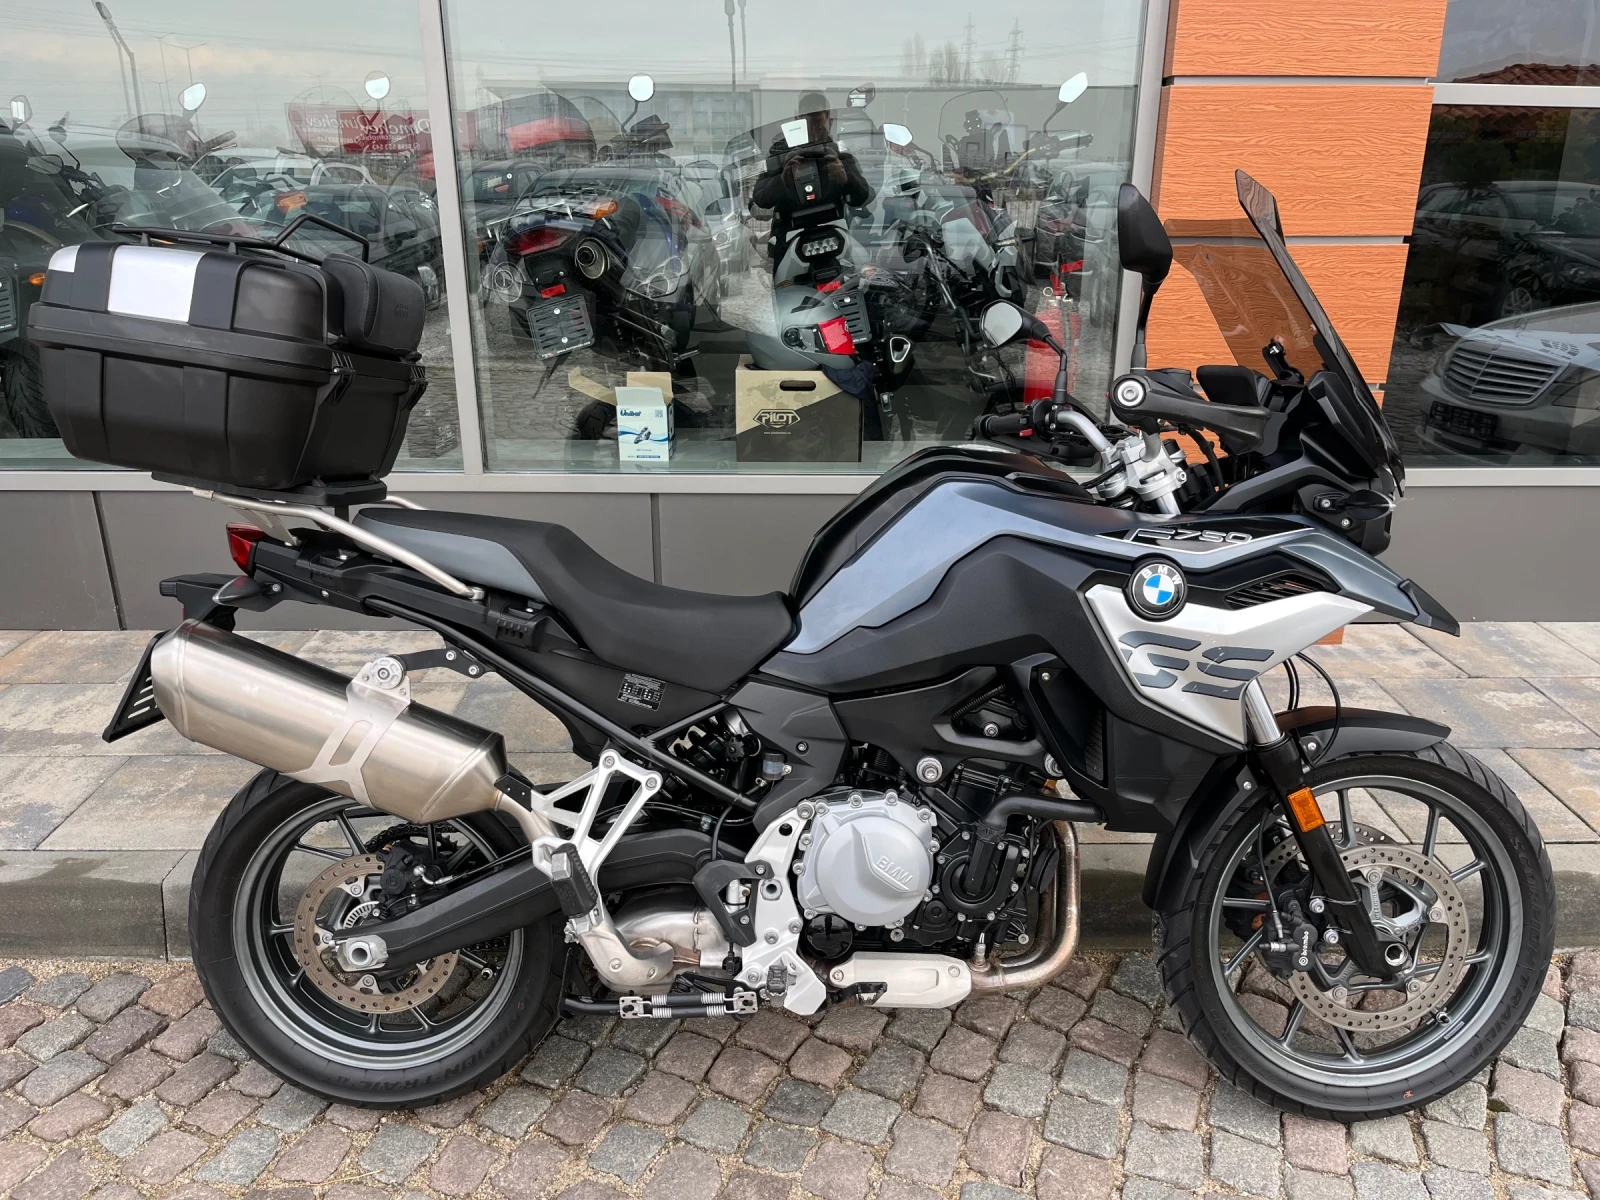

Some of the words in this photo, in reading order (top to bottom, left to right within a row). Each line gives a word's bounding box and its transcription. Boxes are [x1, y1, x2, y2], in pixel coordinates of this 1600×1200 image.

[1140, 564, 1182, 586] BMW
[1118, 630, 1275, 701] GS
[876, 855, 914, 886] BMW
[1508, 834, 1543, 969] SCORPION
[1301, 930, 1309, 956] brembo
[1483, 973, 1531, 1041] TRAIL
